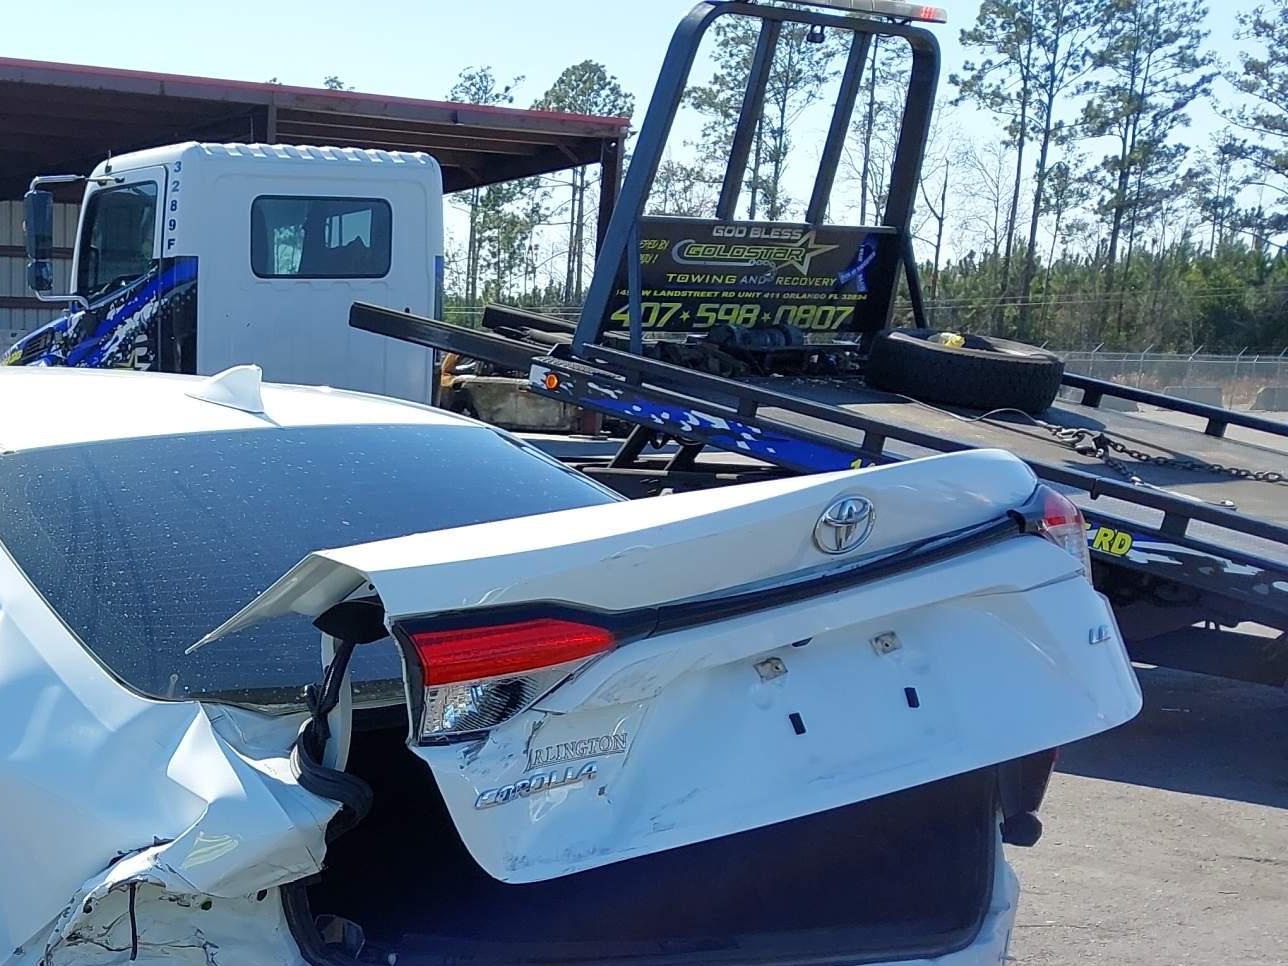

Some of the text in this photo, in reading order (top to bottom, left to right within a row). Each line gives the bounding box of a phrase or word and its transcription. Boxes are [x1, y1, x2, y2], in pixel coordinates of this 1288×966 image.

[167, 160, 182, 250] 3289F
[712, 225, 804, 240] GOD BLESS
[666, 273, 837, 287] TOWING AND RECOVERY
[653, 289, 720, 298] LANDSTREET
[722, 290, 735, 298] RD
[737, 291, 761, 299] UNIT
[783, 292, 827, 300] ORLANDO
[1093, 526, 1132, 555] RD
[1089, 621, 1112, 646] LE
[475, 760, 598, 809] COROLLA
